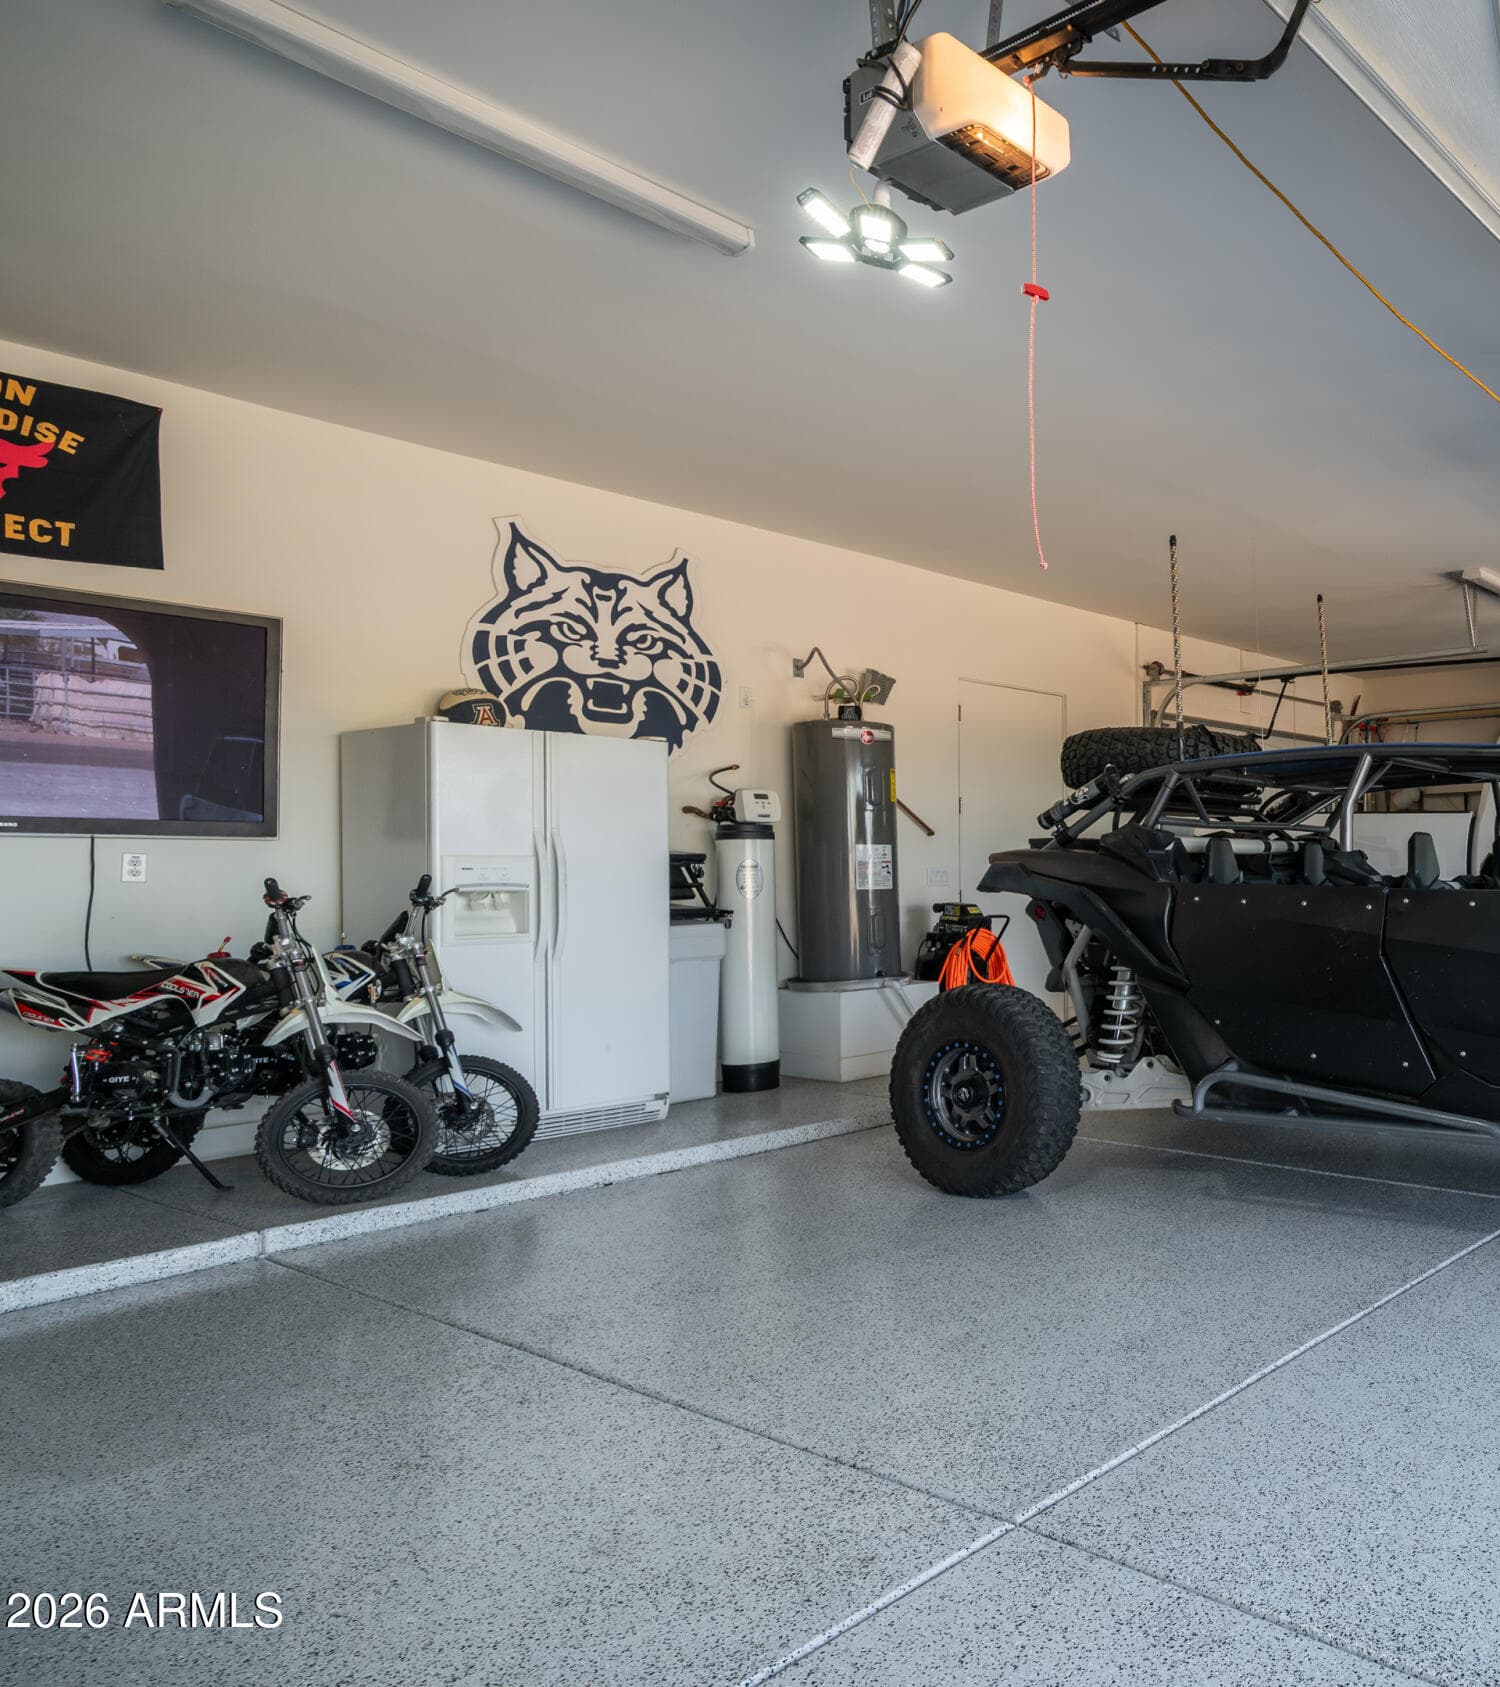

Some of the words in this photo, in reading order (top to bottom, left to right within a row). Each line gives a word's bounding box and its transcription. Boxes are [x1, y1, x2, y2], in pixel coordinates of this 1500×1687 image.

[0, 378, 37, 407] N
[0, 407, 85, 455] DISE
[4, 513, 76, 547] ECT
